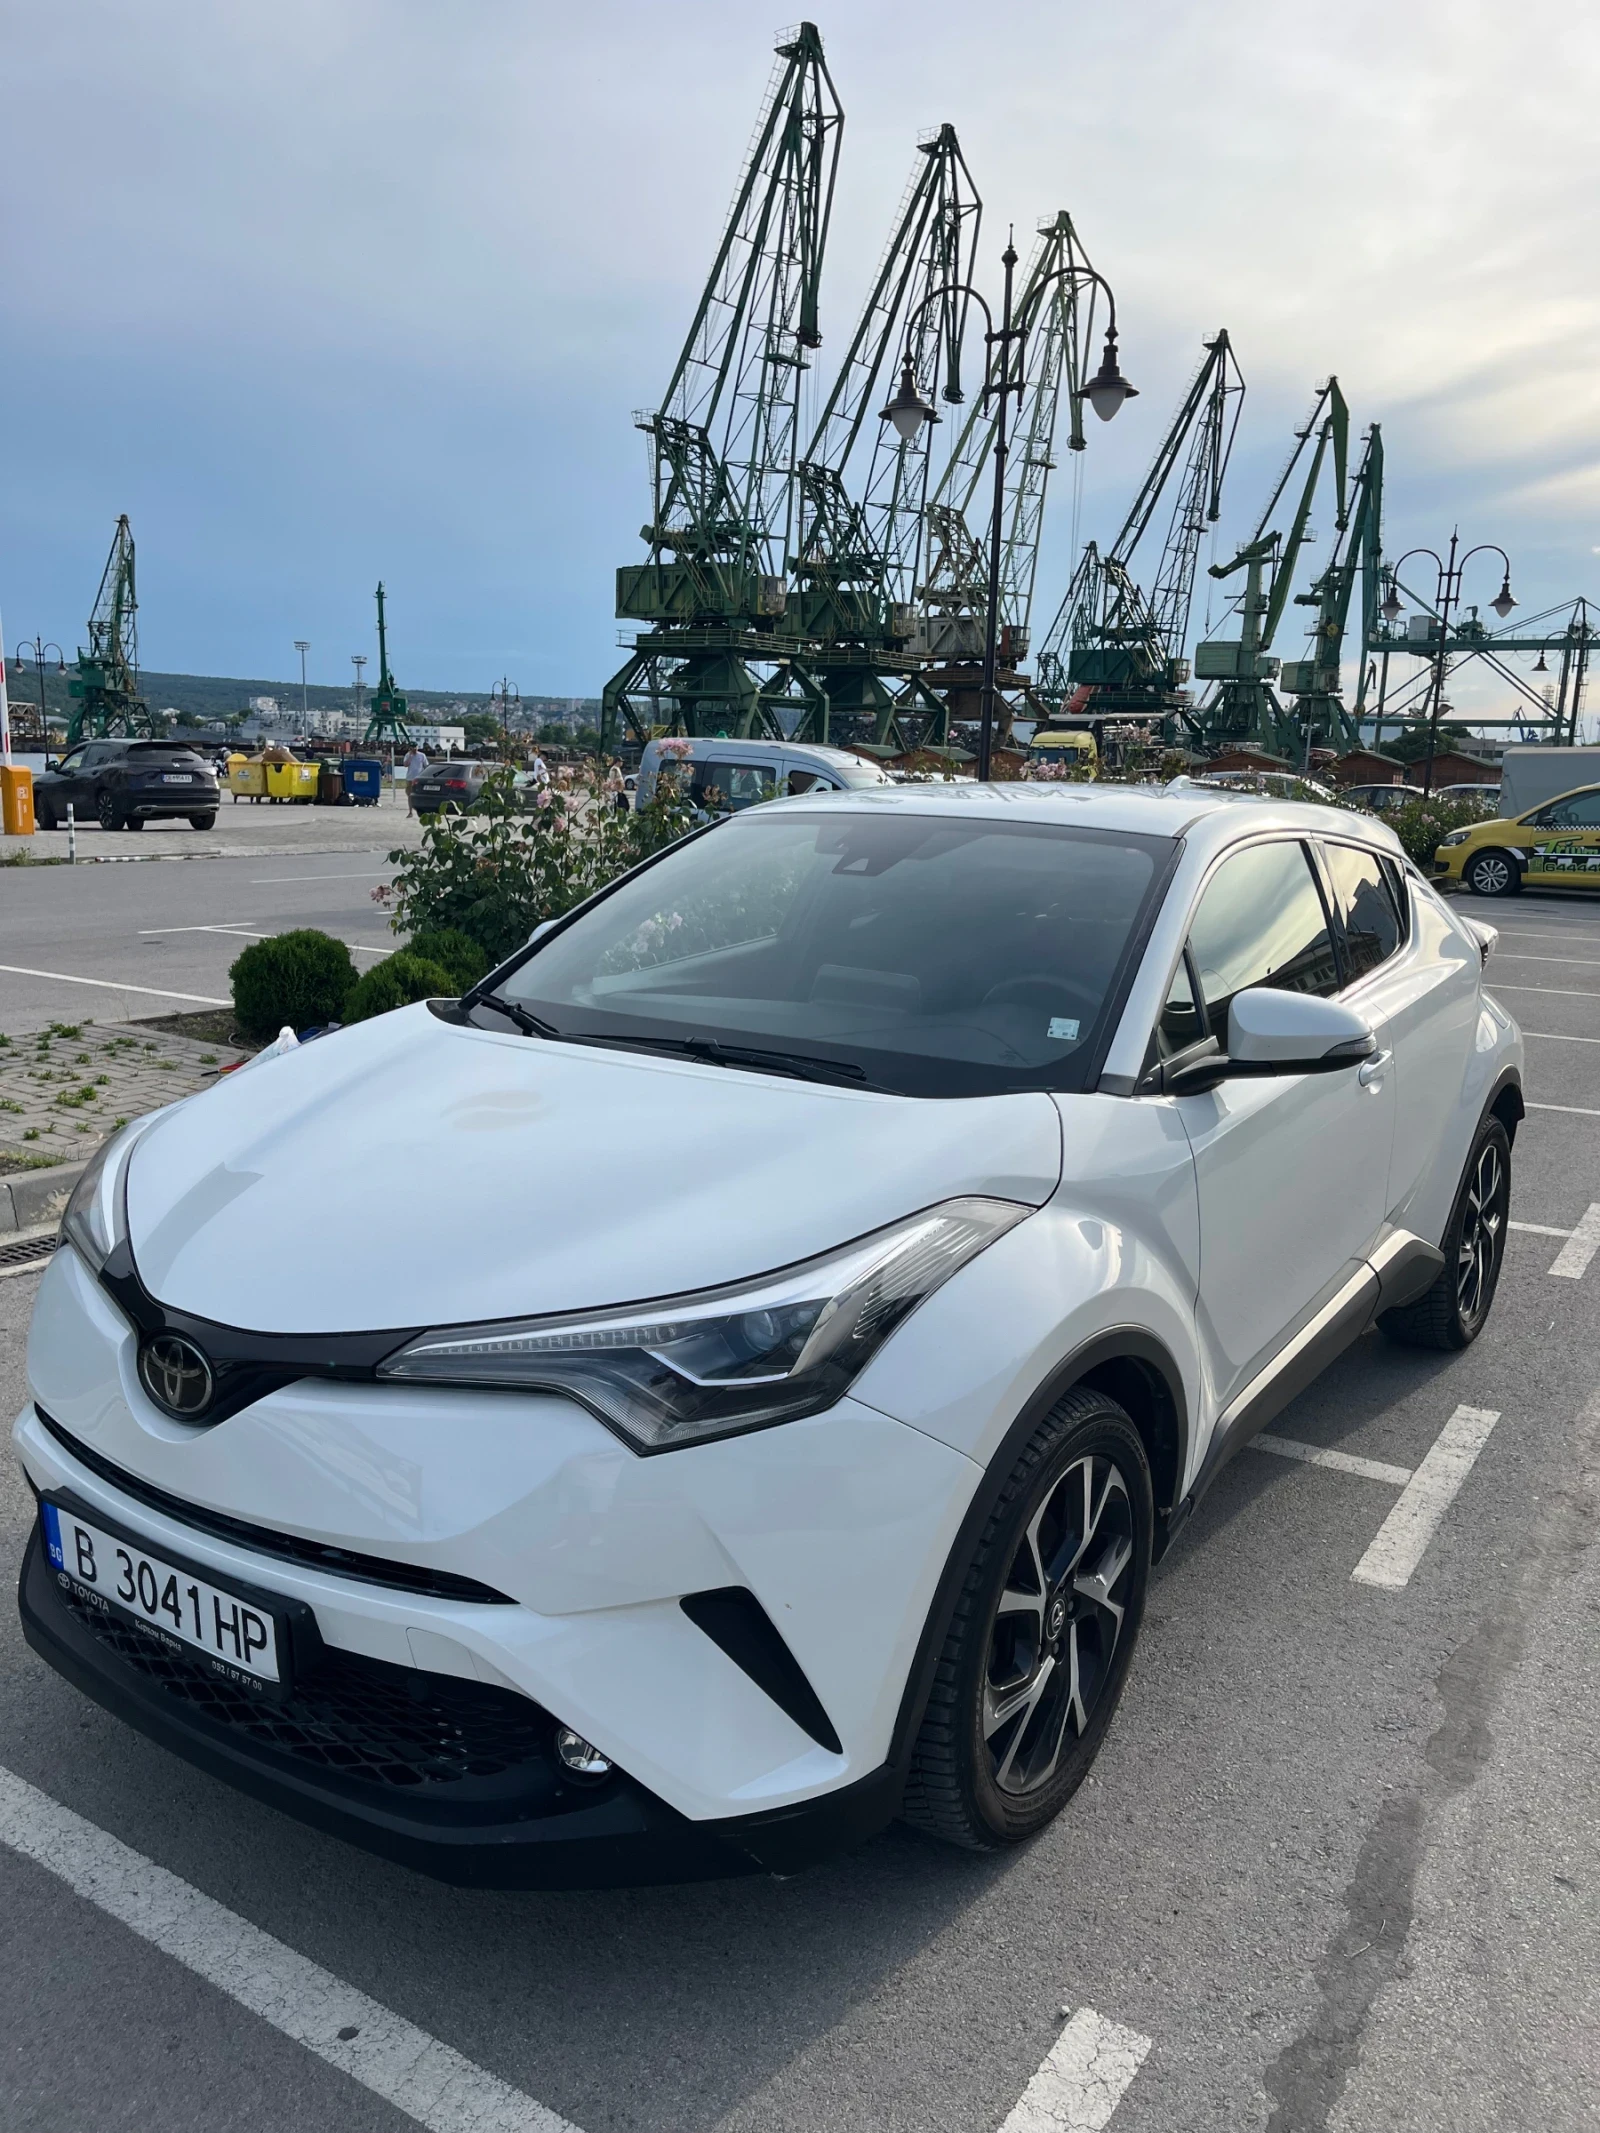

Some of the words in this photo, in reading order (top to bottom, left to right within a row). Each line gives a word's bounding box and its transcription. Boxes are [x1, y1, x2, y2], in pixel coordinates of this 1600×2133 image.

[1545, 862, 1600, 873] 64444
[49, 1542, 63, 1563] BG
[72, 1581, 110, 1614] TOYOTA
[74, 1525, 97, 1583] B
[116, 1548, 203, 1640] 3041
[213, 1594, 267, 1664] HP
[160, 1632, 182, 1652] Варна
[211, 1660, 226, 1675] 052
